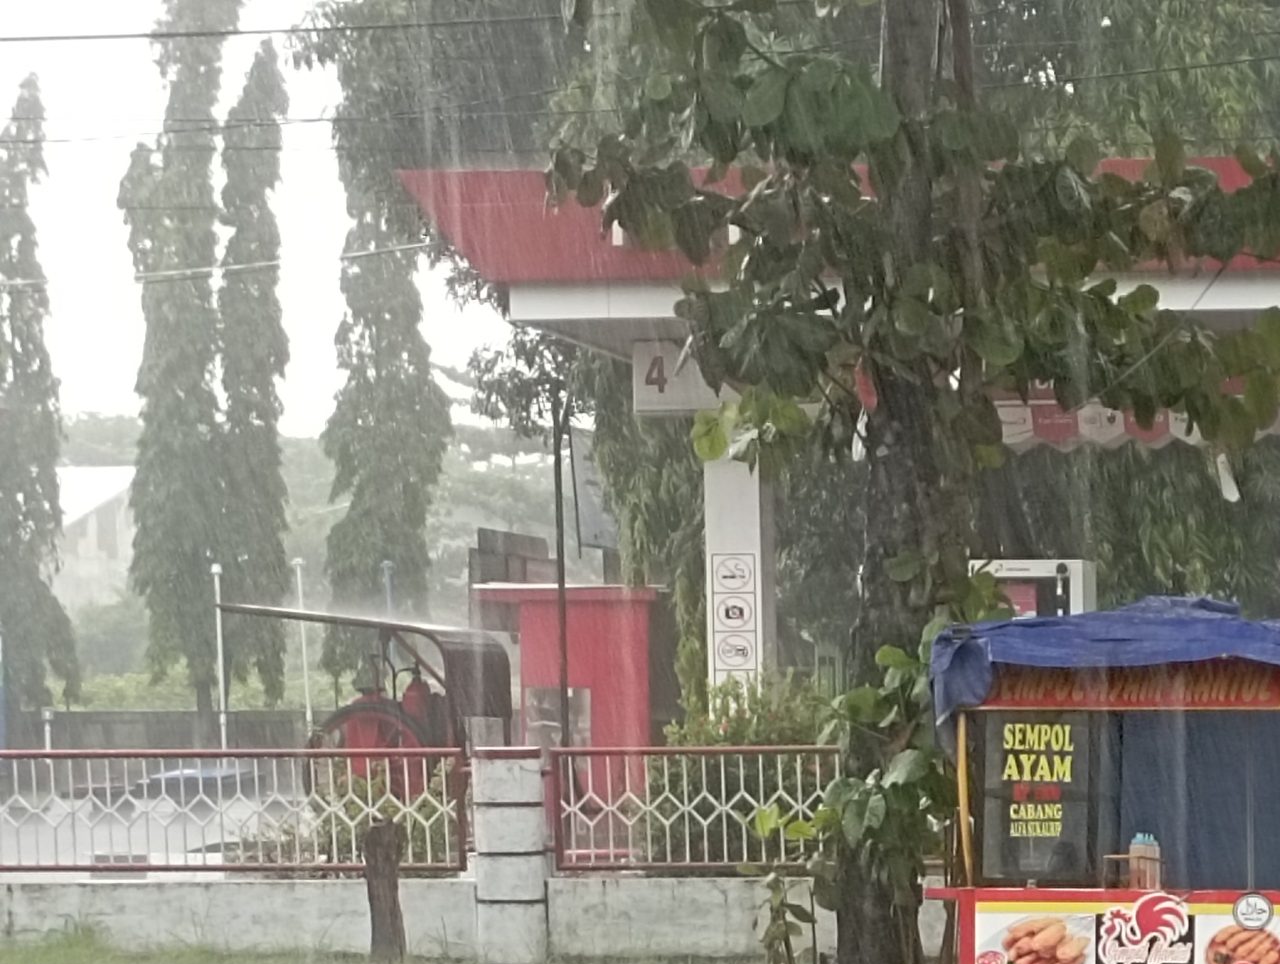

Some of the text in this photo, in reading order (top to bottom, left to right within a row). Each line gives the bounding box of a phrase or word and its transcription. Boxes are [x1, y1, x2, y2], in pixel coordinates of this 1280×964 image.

[645, 355, 668, 394] 4
[1003, 723, 1074, 752] SEMPOL
[1002, 753, 1072, 782] AYAM
[1010, 803, 1062, 820] CABANG
